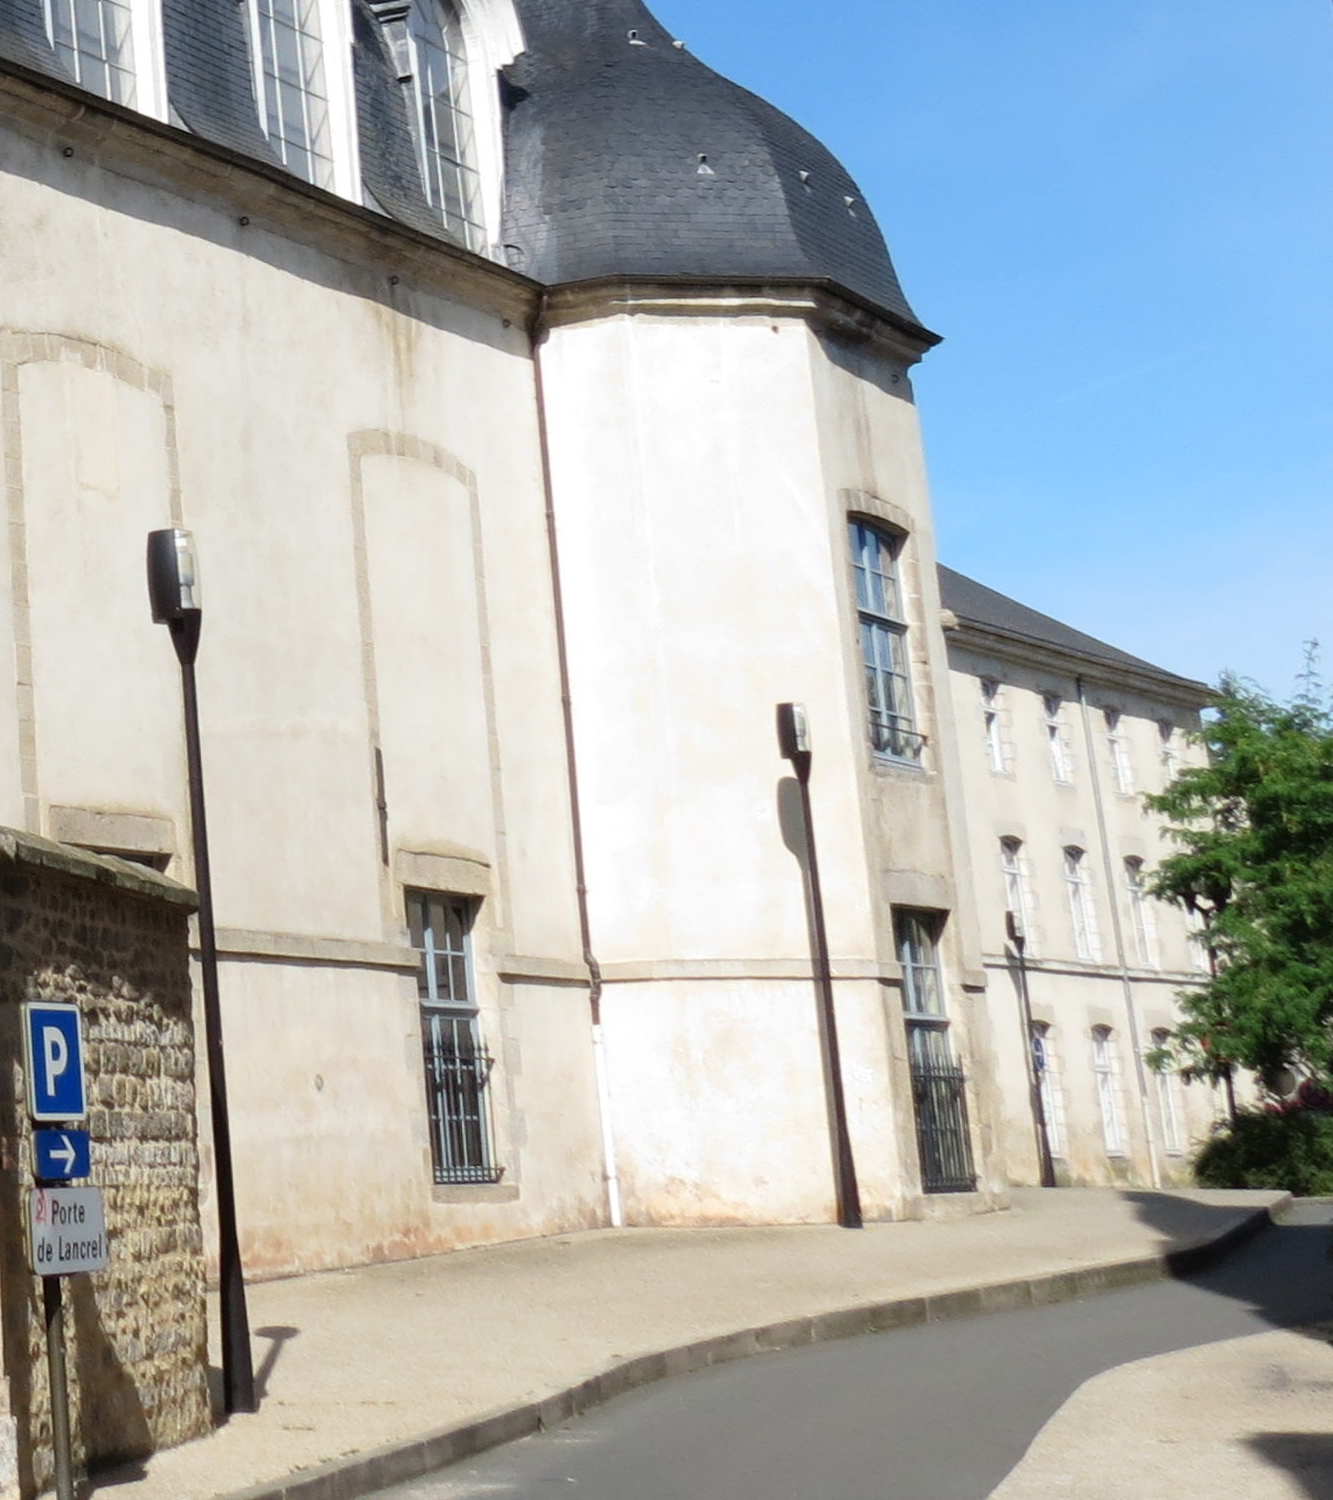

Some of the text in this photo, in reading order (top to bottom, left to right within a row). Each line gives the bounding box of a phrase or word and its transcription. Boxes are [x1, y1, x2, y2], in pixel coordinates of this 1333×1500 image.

[42, 1026, 68, 1097] P
[51, 1200, 85, 1225] Porte
[37, 1234, 103, 1263] de Lancrel
